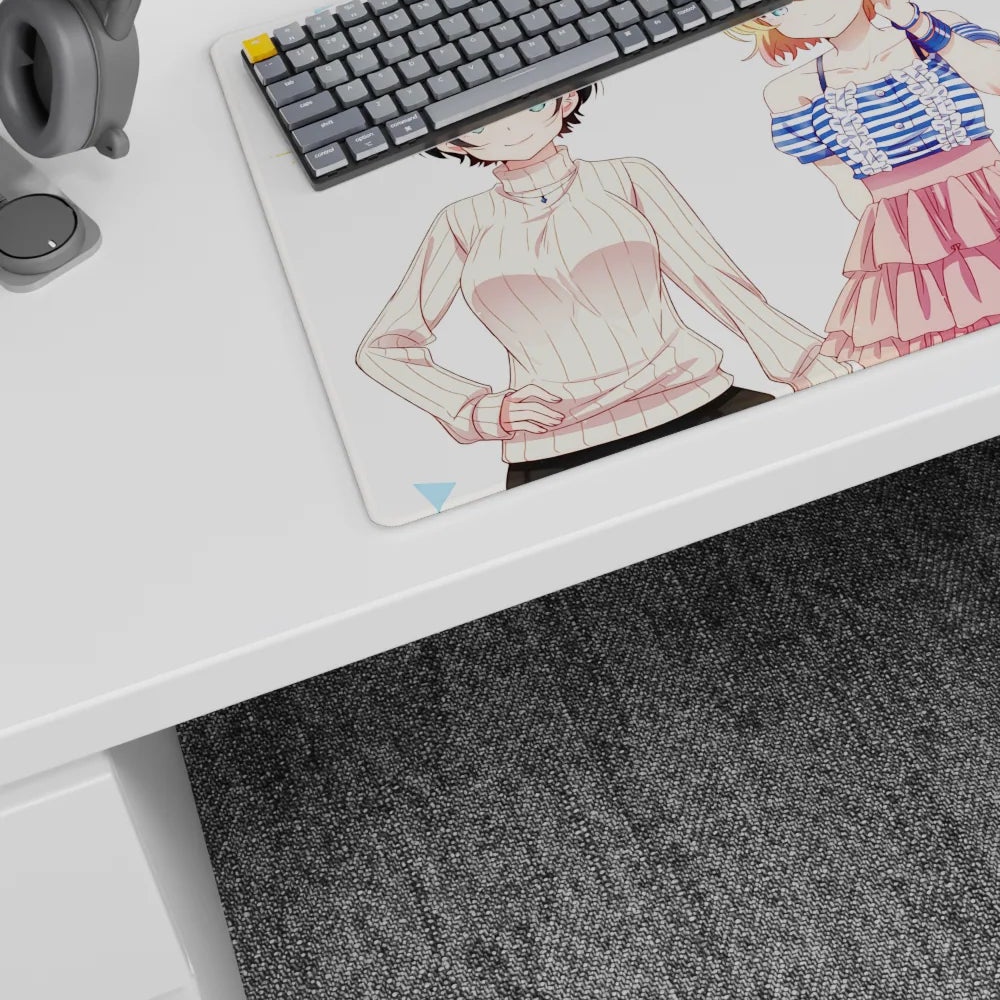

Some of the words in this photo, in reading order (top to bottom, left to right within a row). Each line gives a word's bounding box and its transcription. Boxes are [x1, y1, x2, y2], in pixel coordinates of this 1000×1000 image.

[677, 5, 697, 16] control
[390, 113, 418, 128] command
[355, 131, 375, 142] option
[314, 147, 335, 159] control
